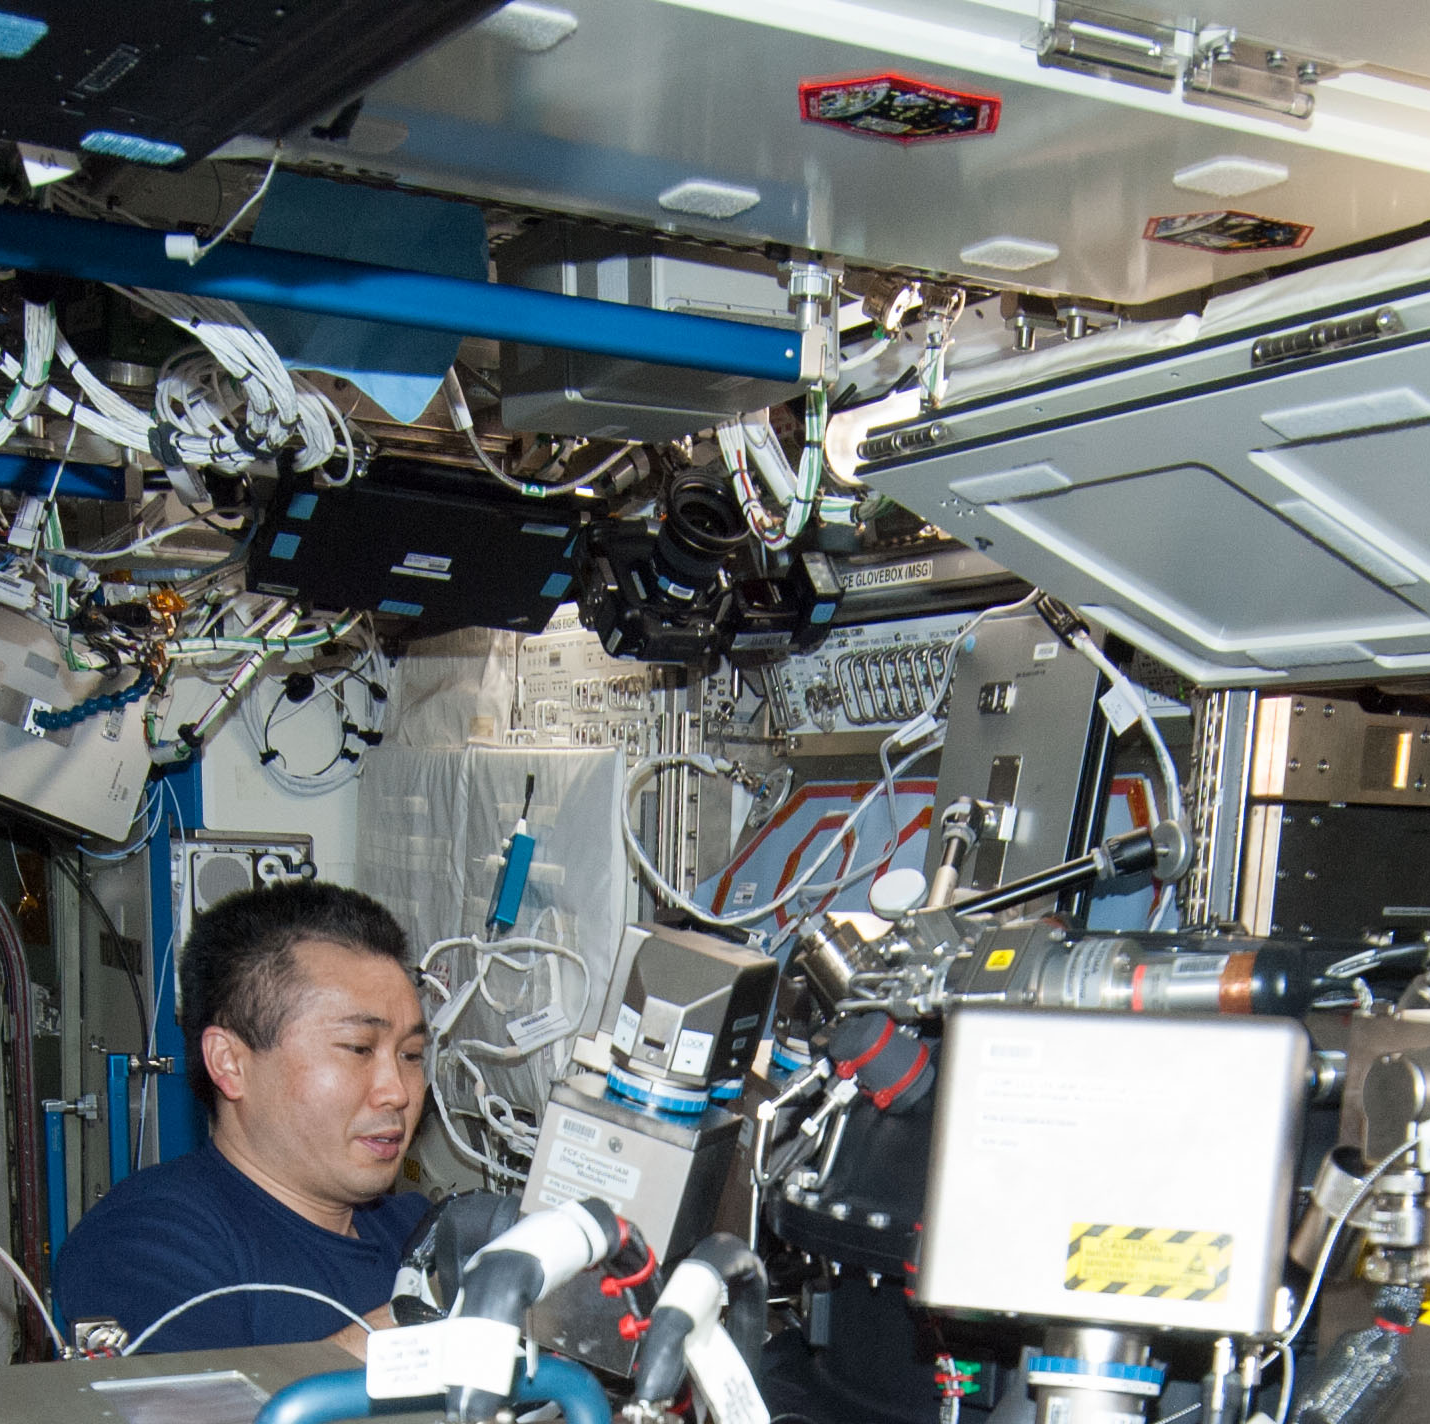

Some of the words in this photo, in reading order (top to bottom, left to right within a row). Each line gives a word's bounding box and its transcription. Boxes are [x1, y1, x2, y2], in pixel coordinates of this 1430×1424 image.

[841, 572, 854, 589] CE
[855, 566, 903, 588] GLOVEBOX
[904, 561, 932, 579] (MSG)
[562, 616, 580, 630] EIGHT
[681, 1037, 705, 1049] LOCK
[562, 1146, 578, 1158] FCF
[579, 1151, 613, 1171] Common
[559, 1154, 585, 1170] (Image
[586, 1162, 628, 1185] Acquisition
[576, 1168, 607, 1187] Module)
[1100, 1239, 1163, 1254] CAUTION
